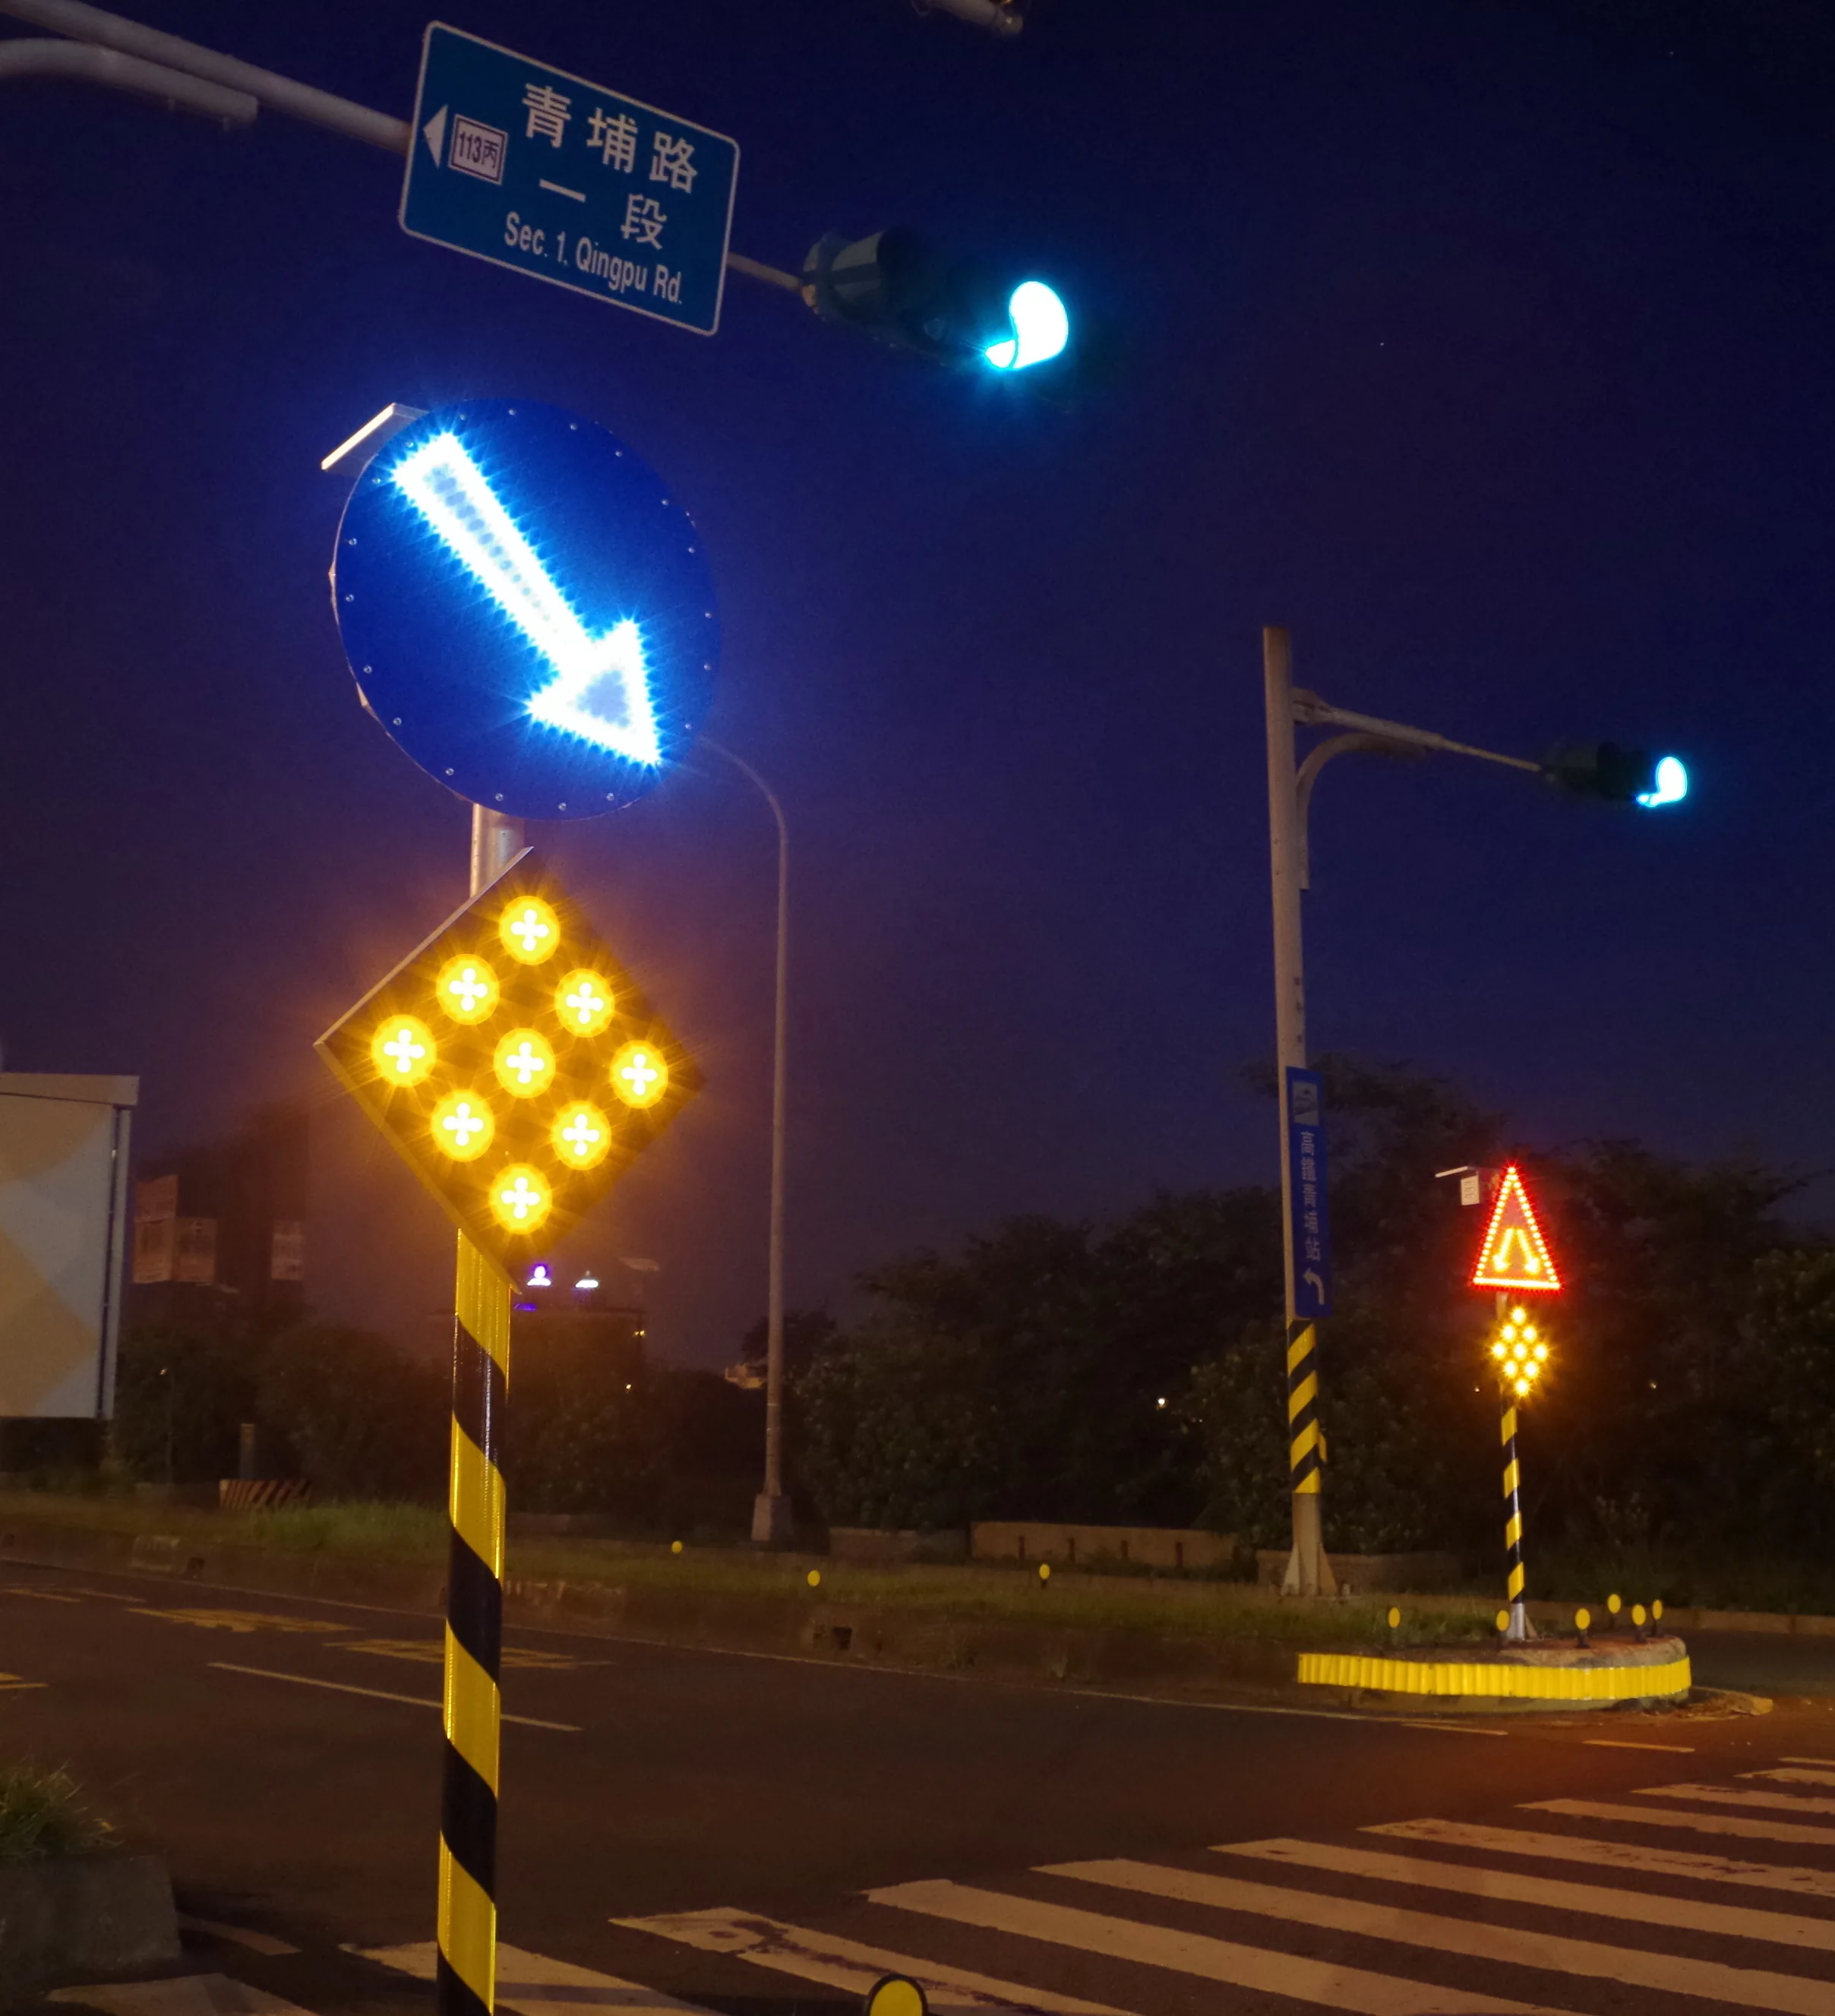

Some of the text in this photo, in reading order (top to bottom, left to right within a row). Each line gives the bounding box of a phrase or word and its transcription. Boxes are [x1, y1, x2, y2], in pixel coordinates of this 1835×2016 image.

[460, 131, 500, 169] 113丙
[522, 83, 697, 193] 青埔路
[539, 179, 667, 250] 一段
[504, 211, 548, 258] Sec.
[576, 236, 647, 293] Qingpu
[654, 264, 683, 304] Rd.
